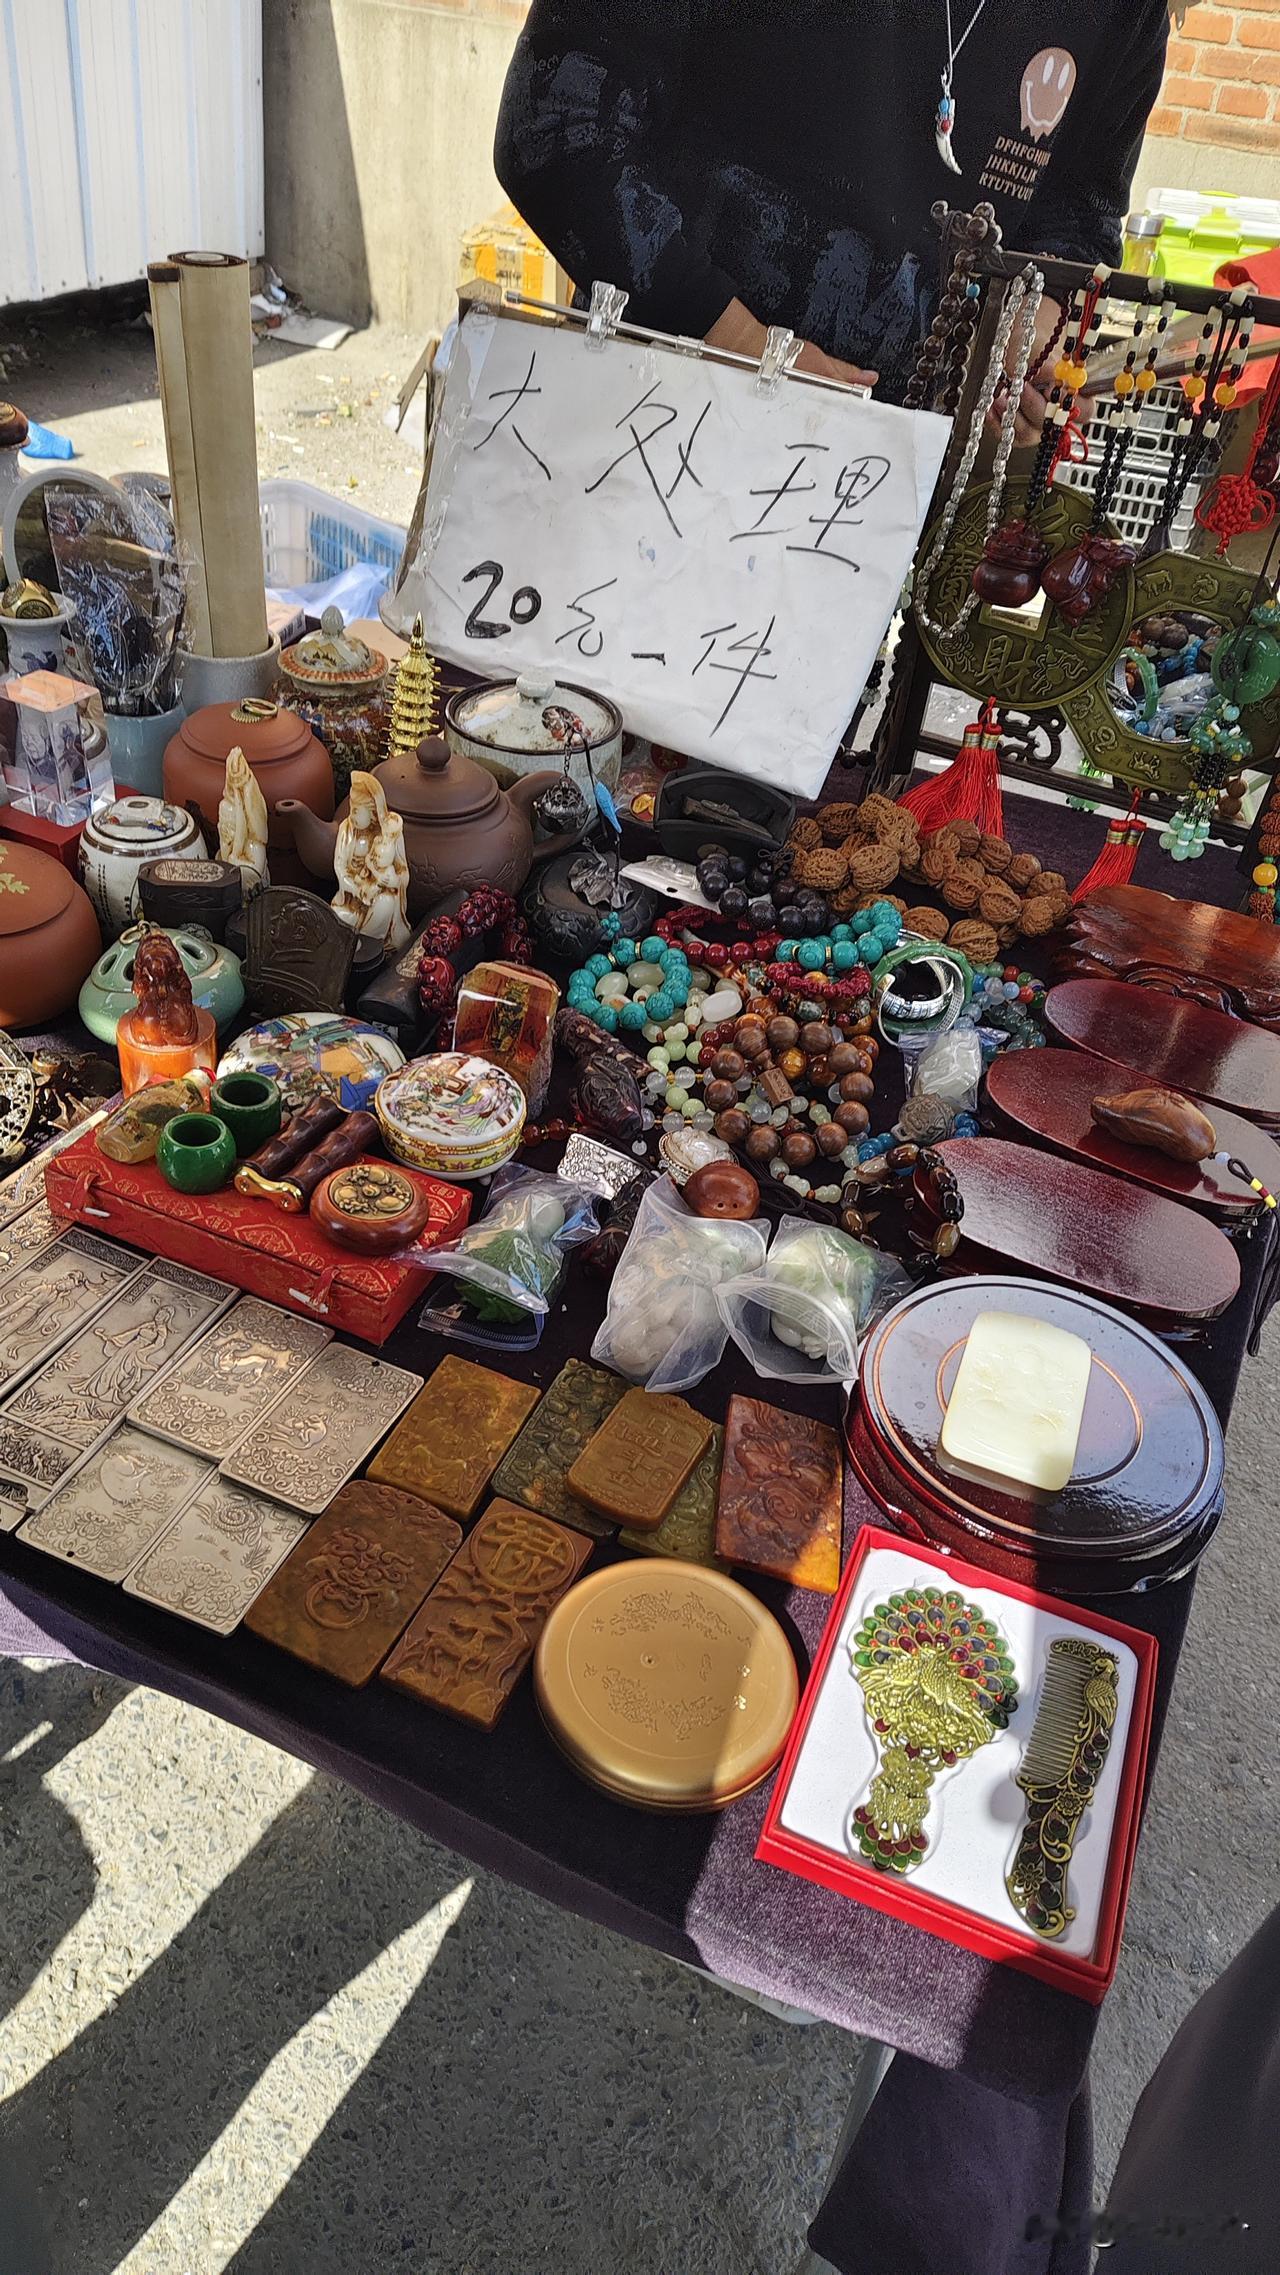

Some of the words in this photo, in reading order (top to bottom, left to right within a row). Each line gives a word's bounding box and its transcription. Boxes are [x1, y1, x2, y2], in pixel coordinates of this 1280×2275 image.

[473, 350, 891, 573] 大处理
[461, 560, 779, 738] 20元一件
